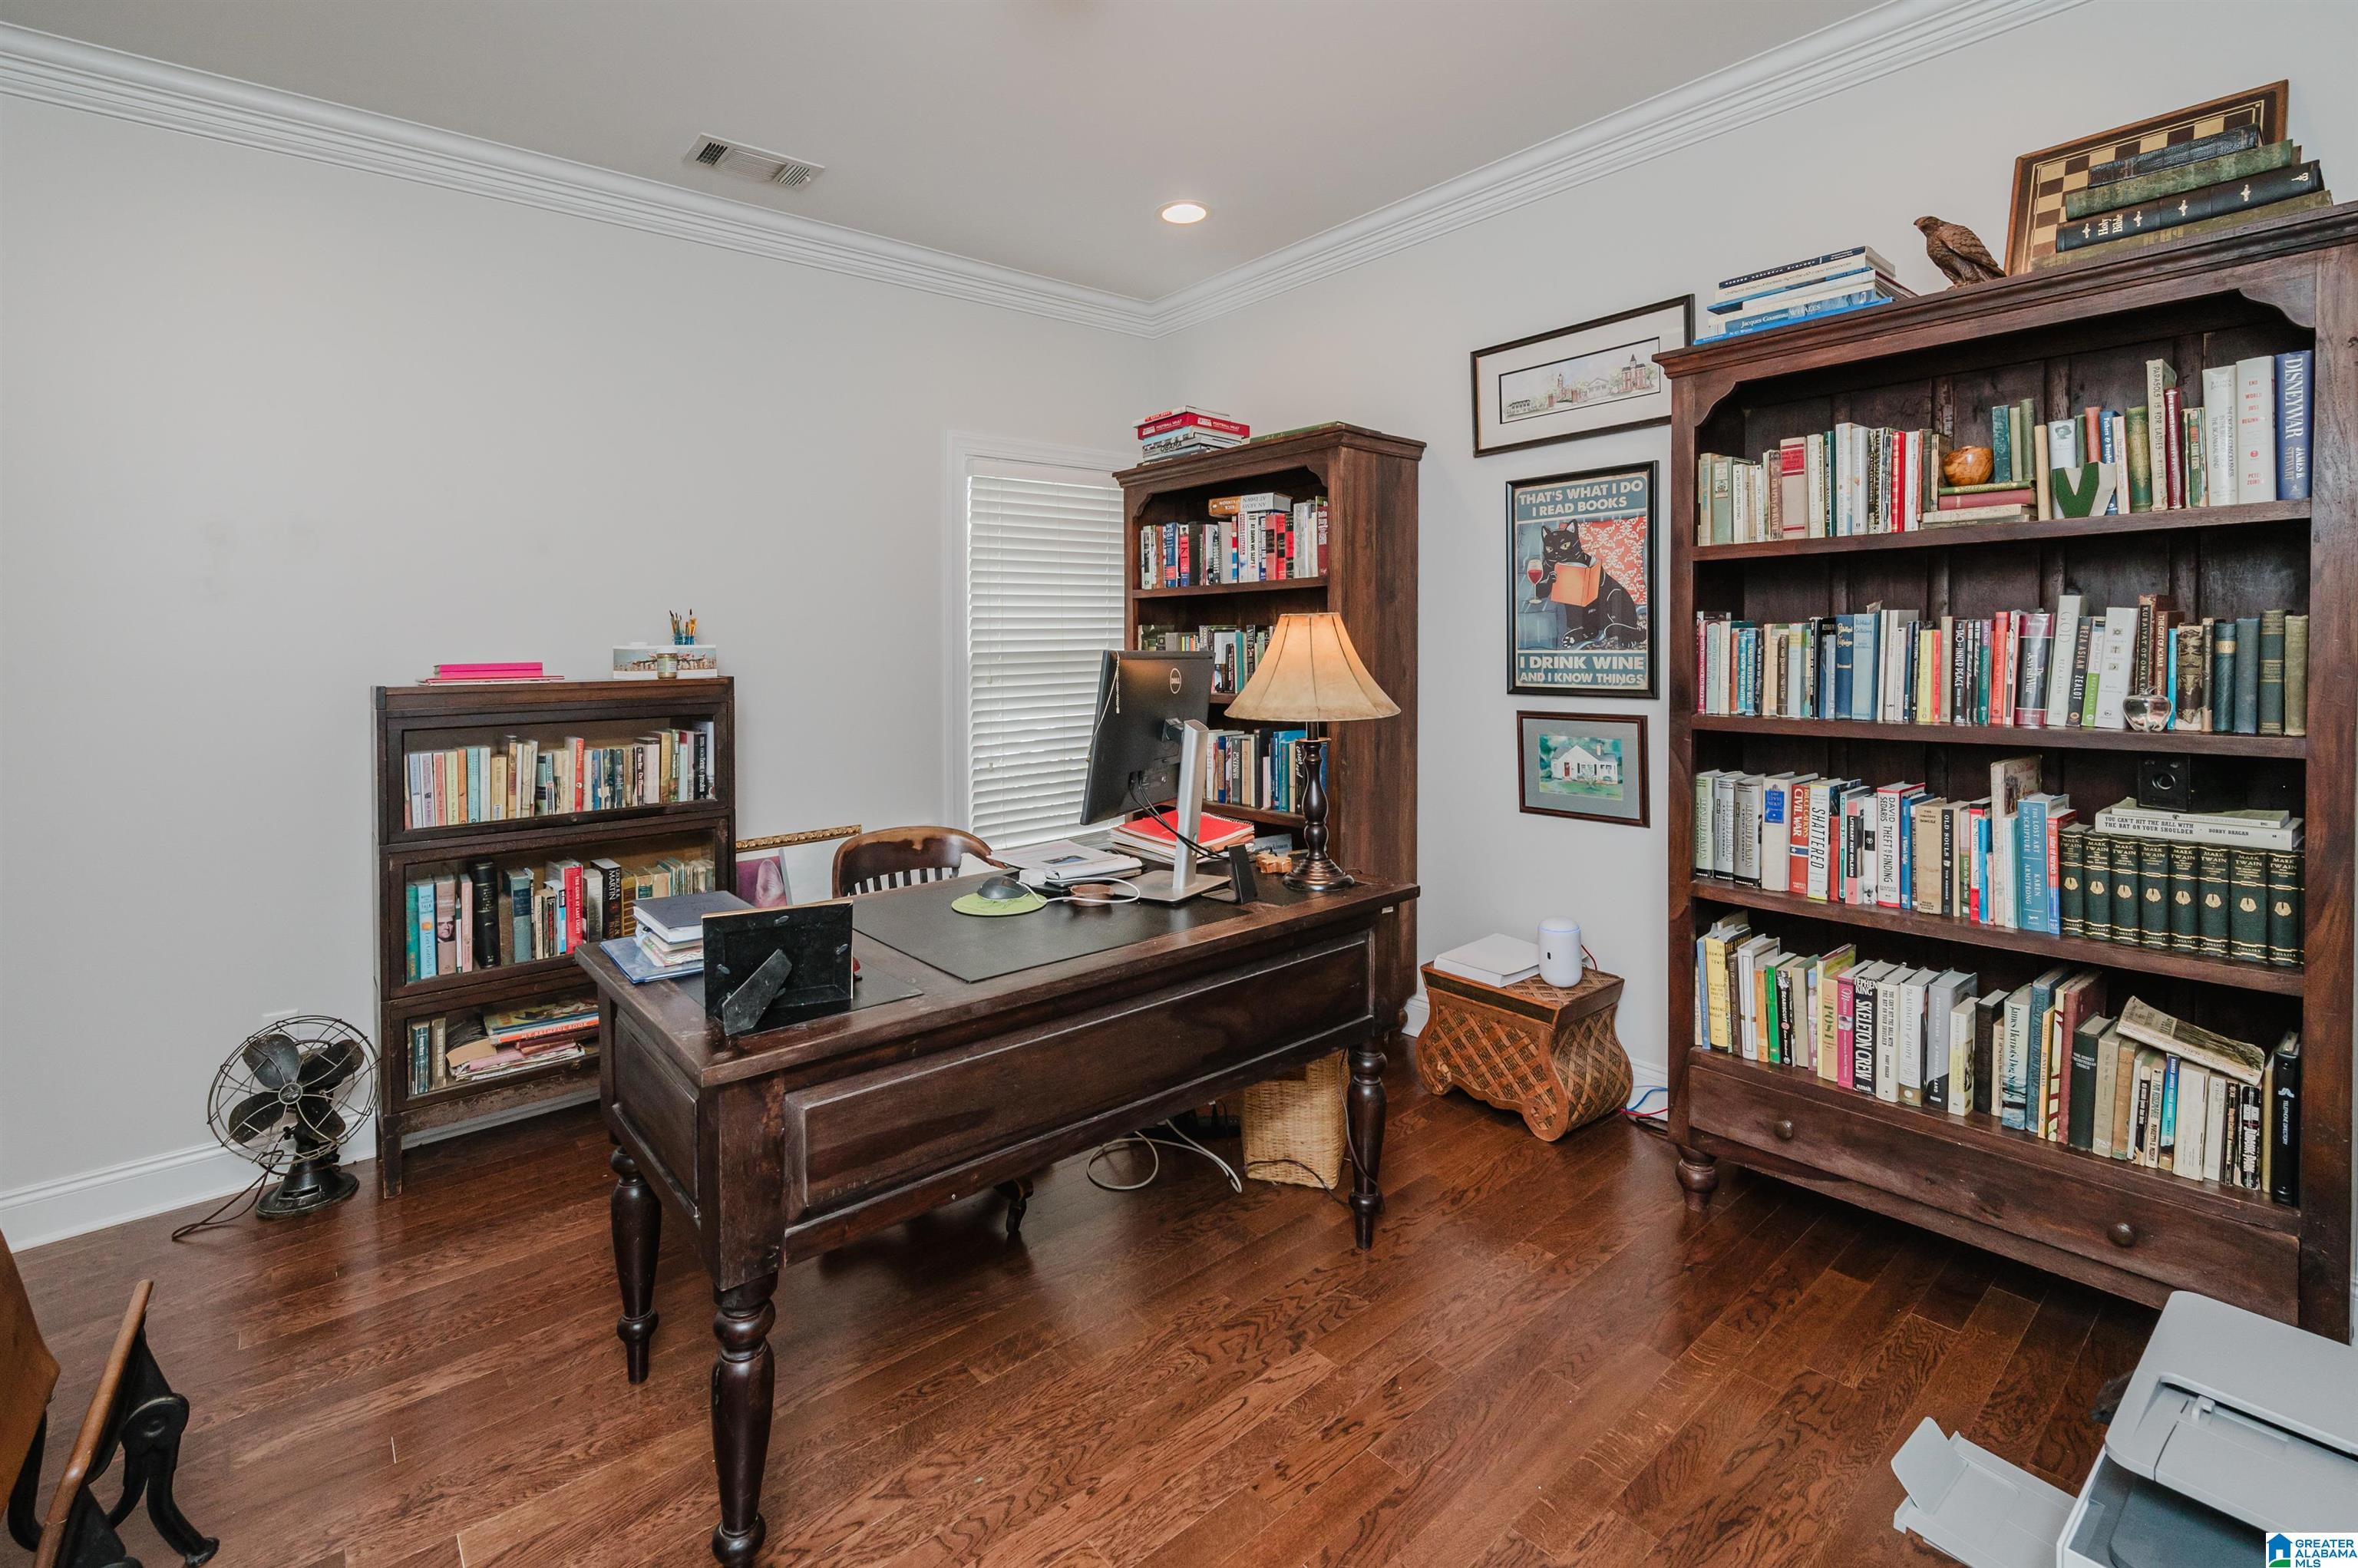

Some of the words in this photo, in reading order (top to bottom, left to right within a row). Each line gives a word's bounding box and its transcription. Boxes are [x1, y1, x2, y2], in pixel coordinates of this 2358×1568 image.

[2098, 219, 2112, 236] Holy
[2112, 214, 2122, 233] Bible
[1741, 319, 1762, 328] Jacques
[1762, 312, 1788, 322] Cousteau
[2284, 358, 2304, 440] DISNEYWAR
[2284, 447, 2294, 480] STEWART
[2296, 447, 2305, 473] JAMES
[1520, 489, 1563, 506] THAT'S
[1567, 484, 1608, 499] WHAT
[1612, 482, 1617, 494] I
[1620, 480, 1643, 493] DO
[1532, 507, 1536, 517] I
[1539, 503, 1574, 516] READ
[1578, 497, 1627, 512] BOOKS
[1955, 629, 1964, 642] TAO
[2059, 612, 2072, 643] GOD
[2080, 626, 2089, 642] REZA
[1520, 657, 1524, 668] I
[1529, 656, 1587, 669] DRINK
[1592, 655, 1644, 670] WINE
[1955, 648, 1963, 667] INNER
[2076, 646, 2087, 669] ASLAN
[2141, 648, 2148, 658] OF
[2026, 652, 2036, 678] Jewish
[2036, 667, 2044, 676] The
[1520, 673, 1546, 682] AND
[1548, 674, 1551, 682] I
[1554, 673, 1593, 683] KNOW
[1596, 672, 1644, 684] THINGS
[2026, 678, 2036, 694] War
[2073, 675, 2084, 700] ZEALOT
[1794, 788, 1804, 815] CIVIL
[1792, 816, 1802, 837] WAR
[1883, 826, 1892, 848] THEFT
[1811, 807, 1825, 869] SHATTERED
[1883, 854, 1893, 883] FINDING
[1856, 986, 1872, 996] KING
[1855, 999, 1872, 1050] SKELETON
[2010, 1006, 2020, 1028] James
[2011, 1029, 2019, 1058] Herriot's
[1855, 1050, 1872, 1081] CREW
[2009, 1059, 2018, 1074] Dog
[2244, 1127, 2259, 1154] JURASSIC
[2243, 1154, 2257, 1173] PARK
